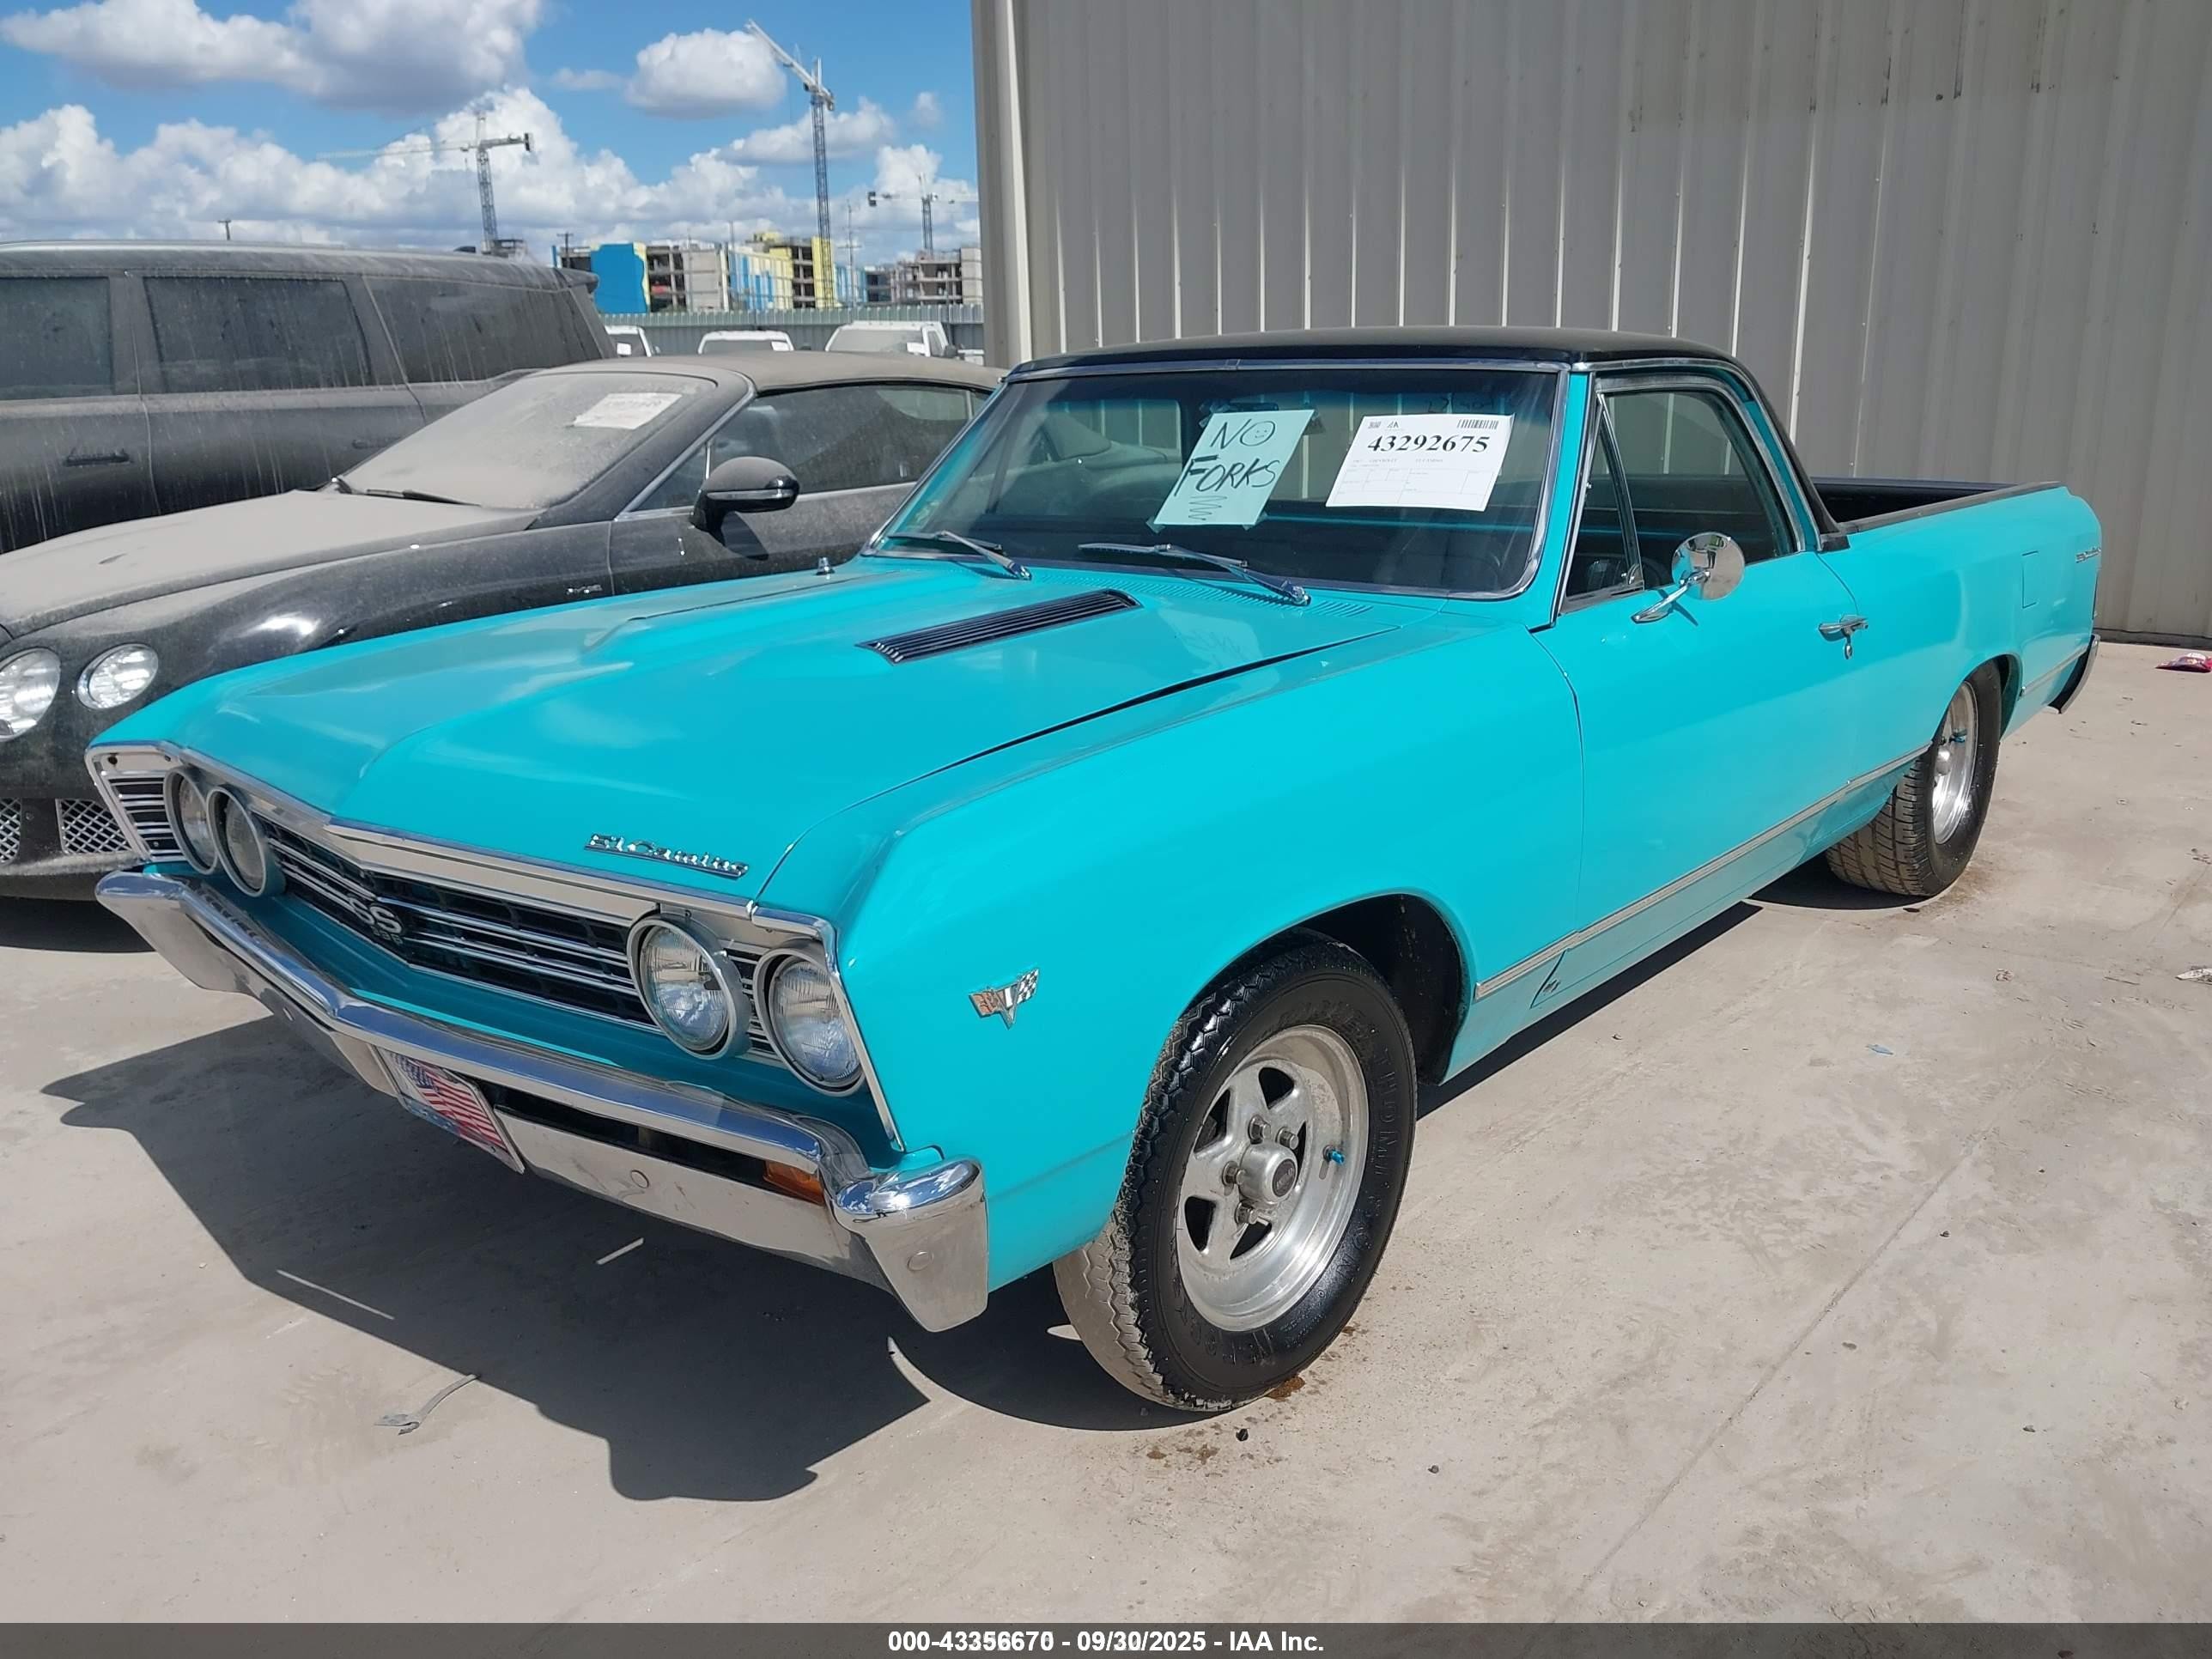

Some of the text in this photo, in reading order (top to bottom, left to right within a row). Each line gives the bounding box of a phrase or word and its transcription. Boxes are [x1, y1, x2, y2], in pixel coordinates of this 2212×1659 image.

[1210, 418, 1277, 450] NO
[1366, 434, 1491, 453] 43292675
[1174, 454, 1281, 497] FORKS
